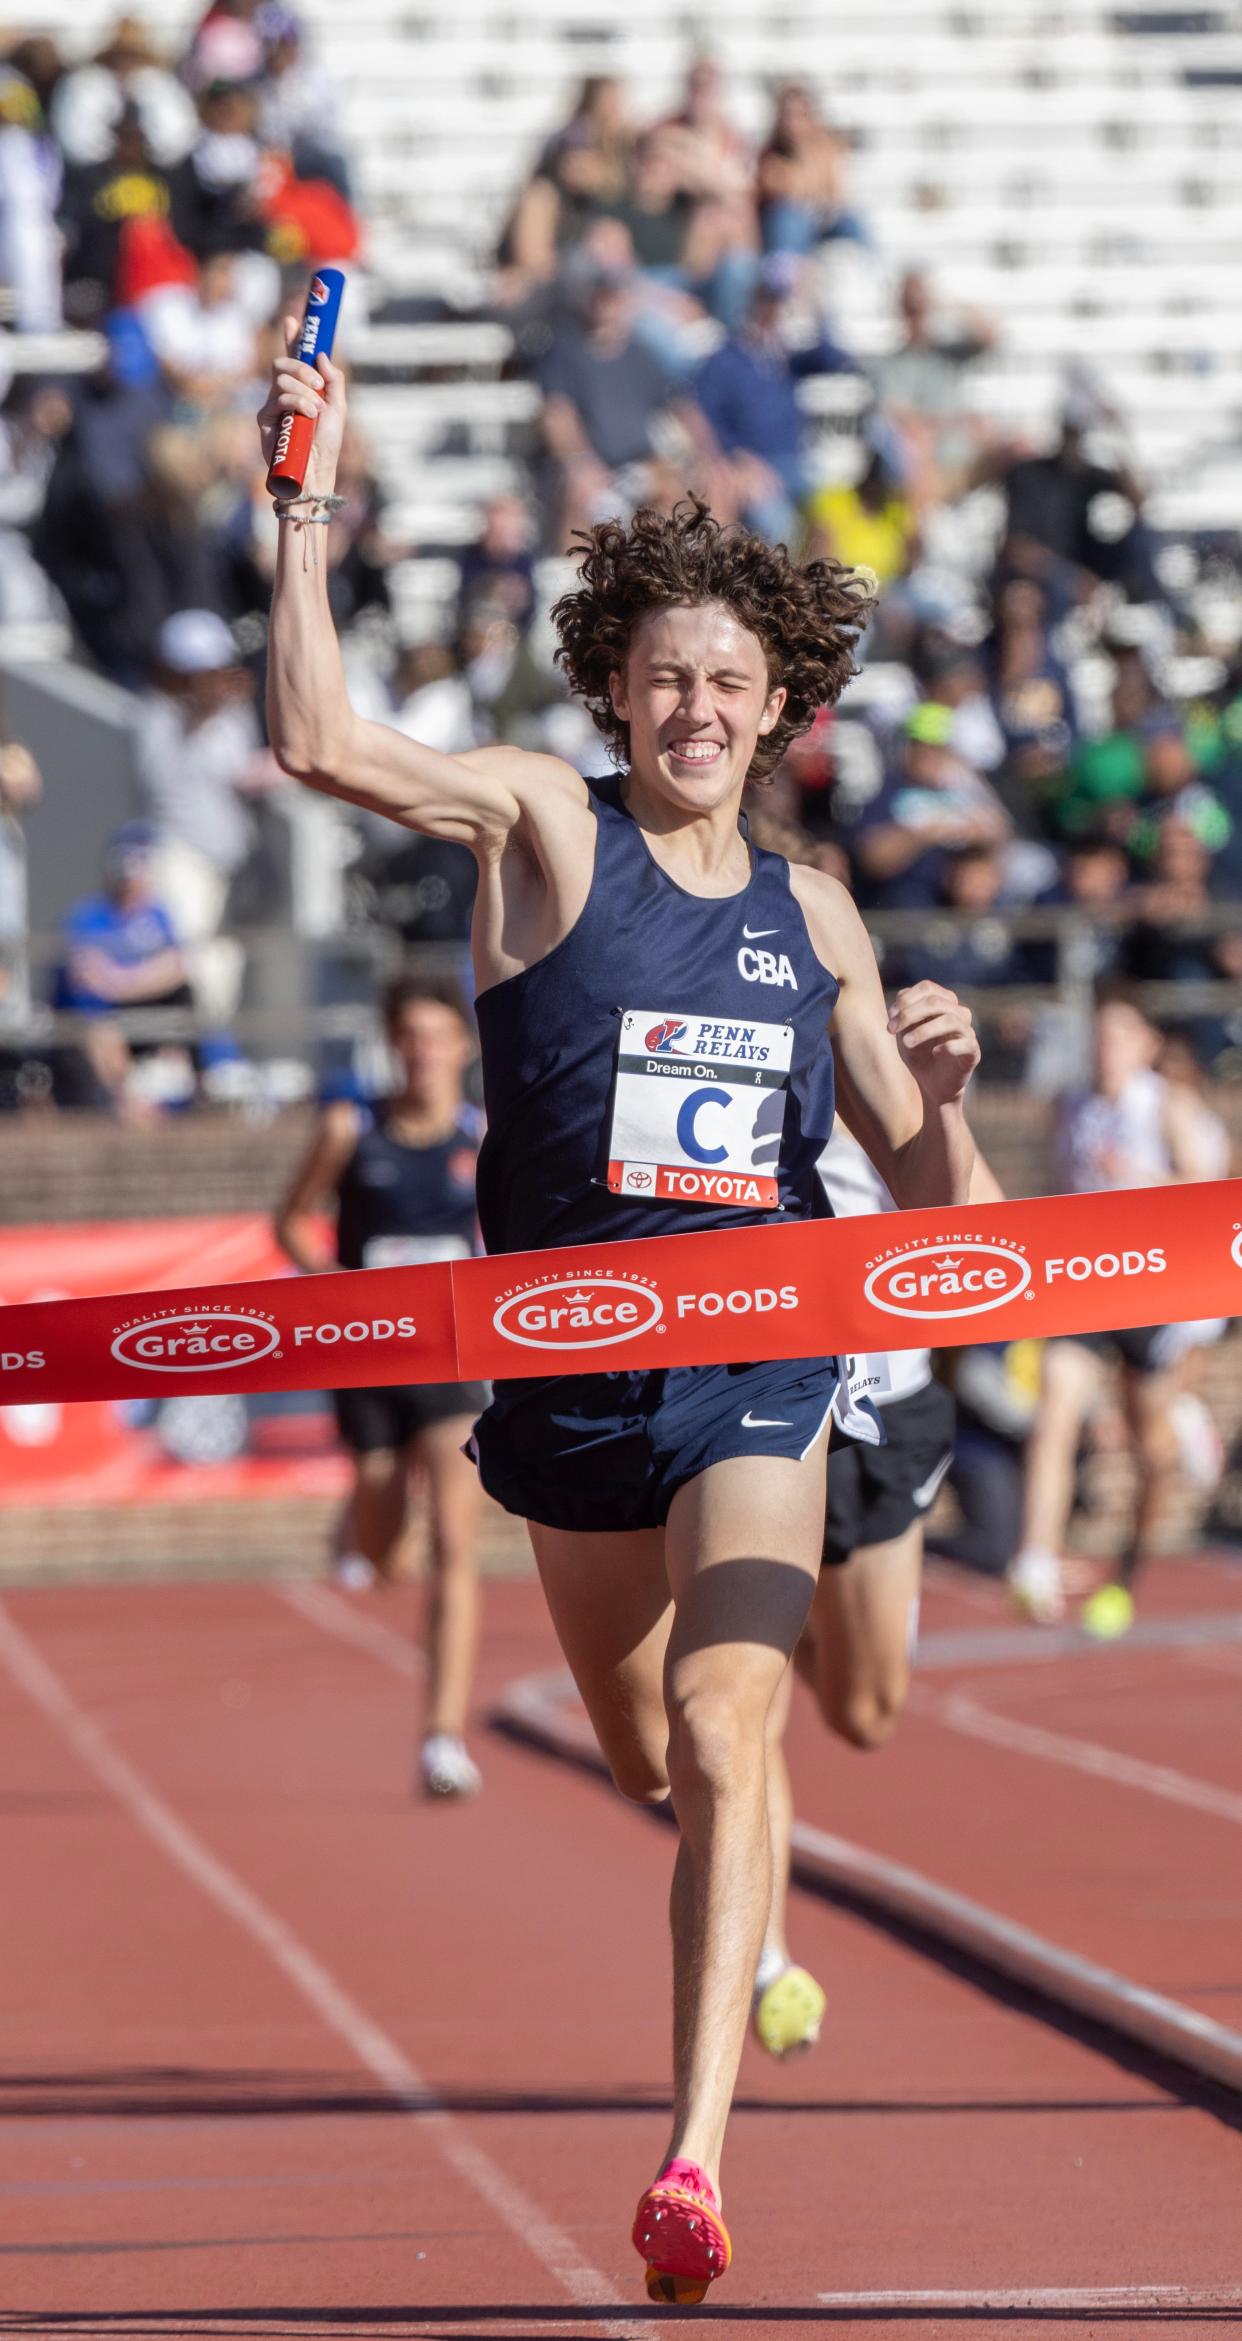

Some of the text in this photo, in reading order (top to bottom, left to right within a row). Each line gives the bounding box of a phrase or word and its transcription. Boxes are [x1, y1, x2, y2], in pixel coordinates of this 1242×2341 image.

[300, 315, 320, 355] PENN
[737, 946, 799, 991] CBA
[697, 1023, 756, 1043] PENN
[693, 1040, 770, 1062] RELAYS
[646, 1060, 718, 1079] Dream On.
[676, 1087, 733, 1165] C
[663, 1171, 761, 1201] TOYOTA
[865, 1234, 1027, 1269] QUALITY SINCE 1922
[494, 1269, 658, 1303] QUALITY SINCE 1922
[888, 1248, 1167, 1298] Grace FOODS
[112, 1308, 177, 1334] QUALITY
[239, 1306, 276, 1322] 1922
[518, 1285, 799, 1331] Grace FOODS
[135, 1316, 417, 1358] Grace FOODS
